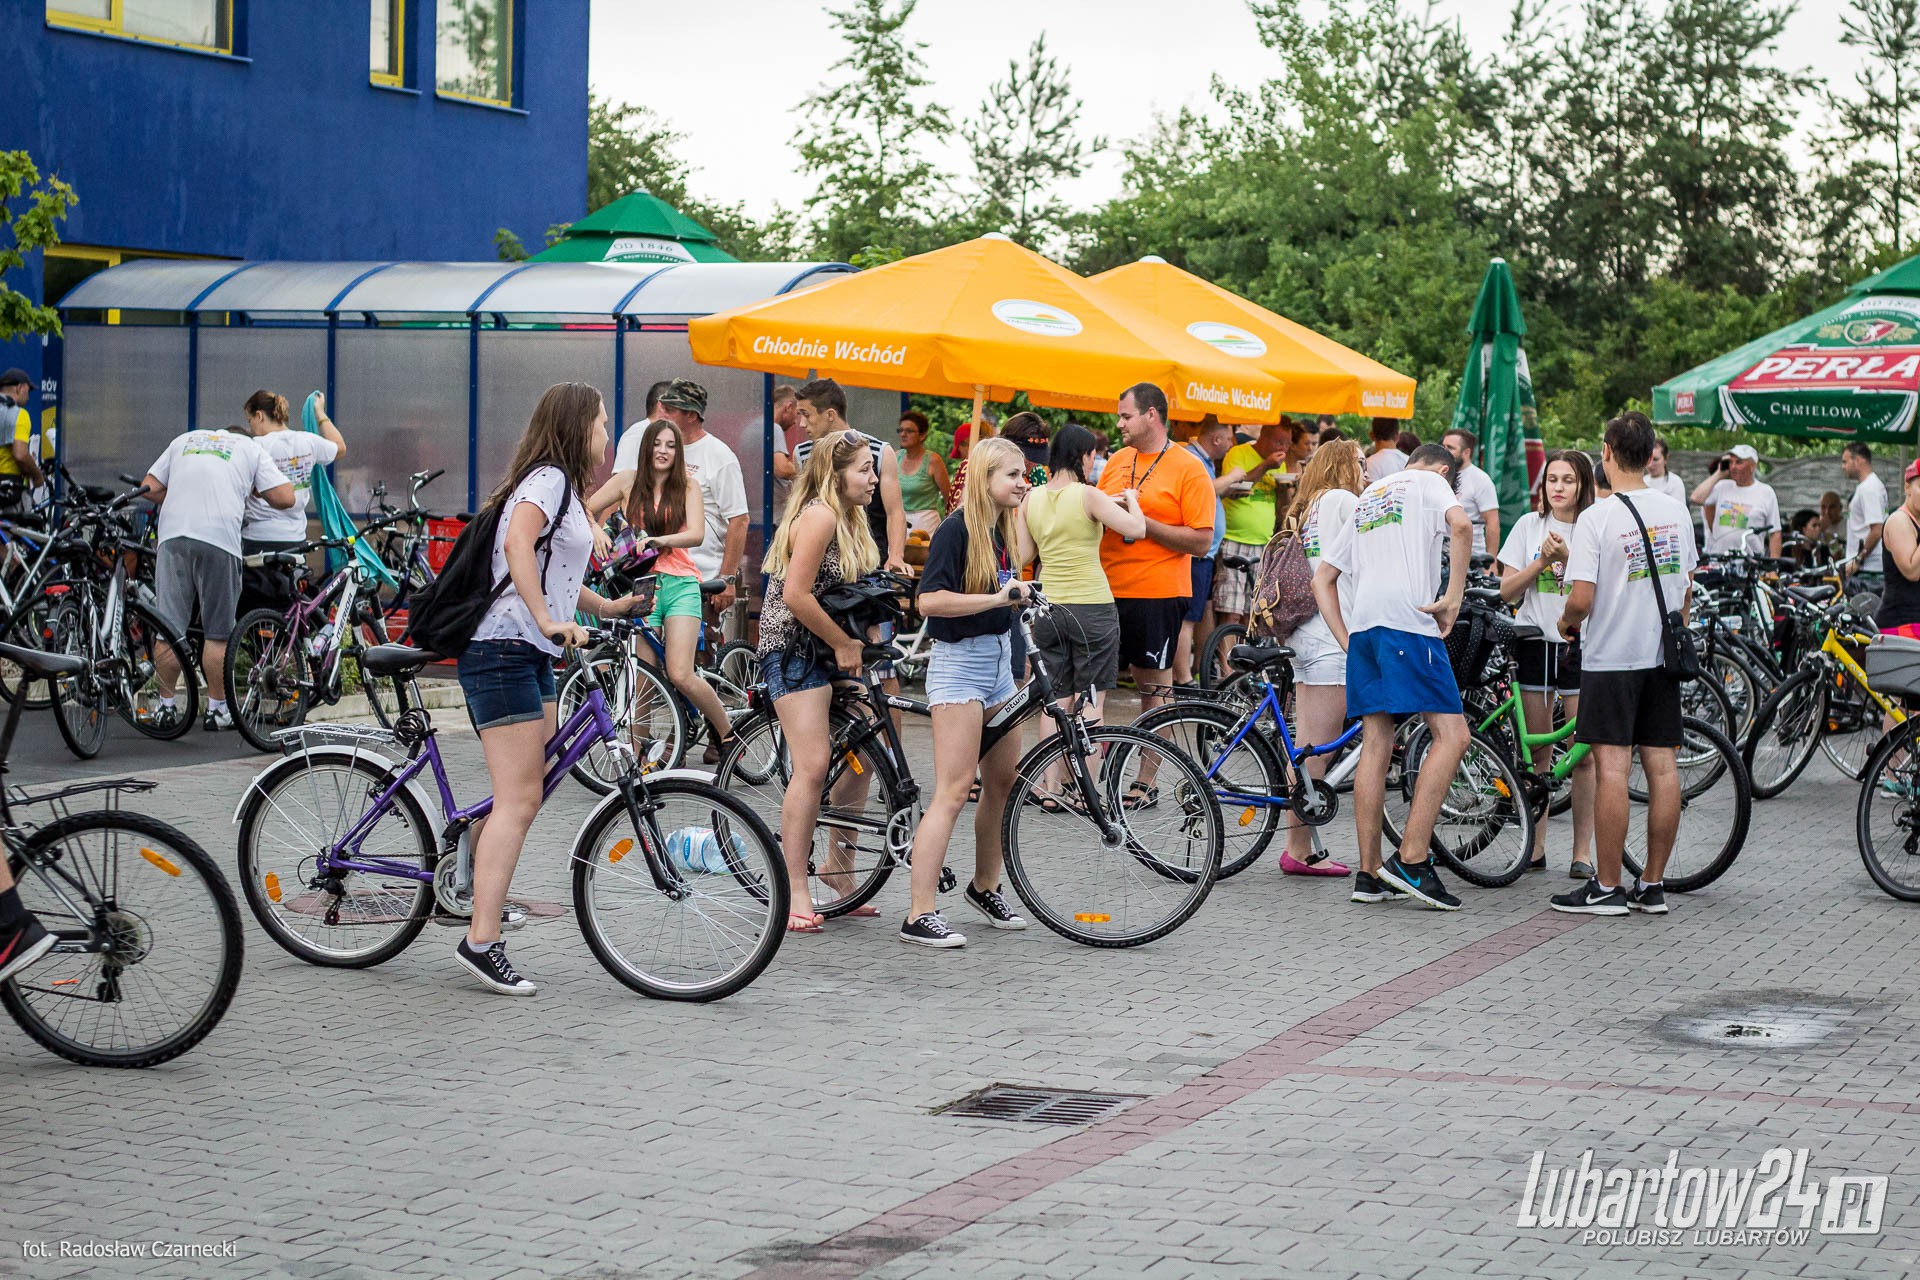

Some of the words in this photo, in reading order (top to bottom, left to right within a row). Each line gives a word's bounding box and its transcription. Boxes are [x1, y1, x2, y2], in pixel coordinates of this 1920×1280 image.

[753, 335, 829, 358] Chłodnie
[834, 340, 907, 366] Wschód
[1744, 354, 1920, 382] PERŁA
[1186, 381, 1230, 405] Chłodnie
[1231, 387, 1272, 411] Wschód
[1770, 402, 1862, 419] CHMIELOWA
